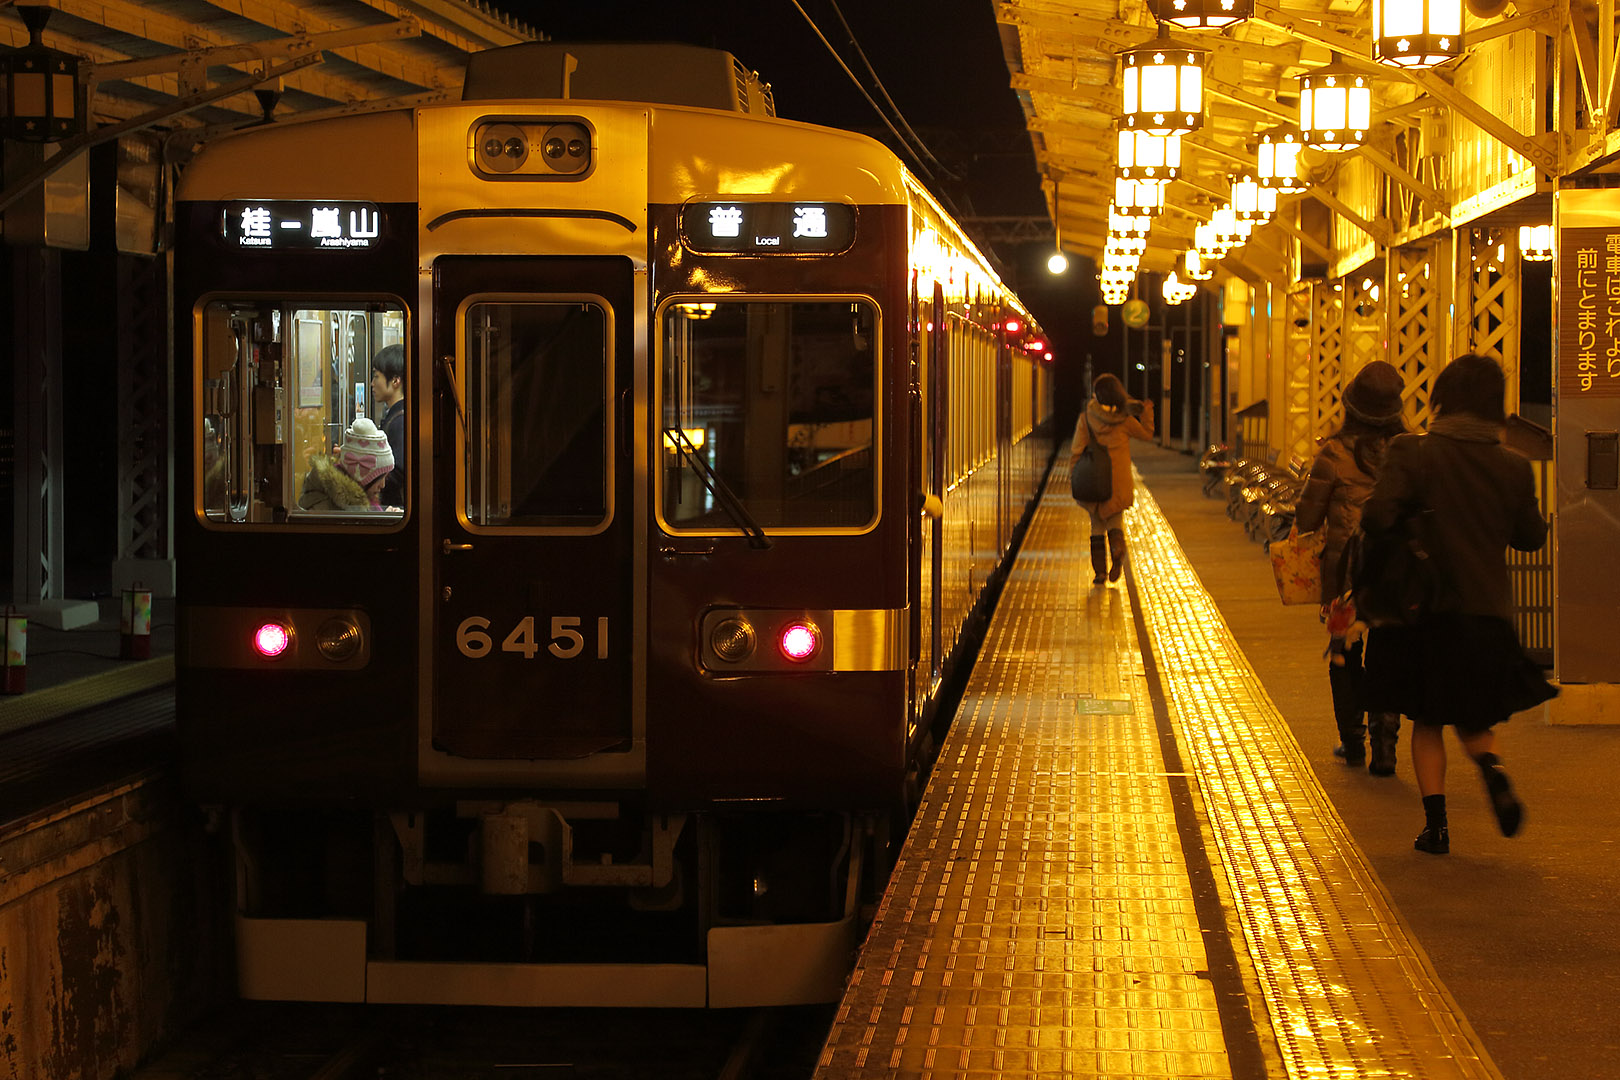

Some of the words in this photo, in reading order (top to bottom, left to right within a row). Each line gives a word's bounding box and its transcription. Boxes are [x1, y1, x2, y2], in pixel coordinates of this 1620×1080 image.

[708, 206, 828, 238] 普通
[239, 236, 272, 246] Katsura
[320, 237, 369, 247] Arashiyama
[755, 236, 780, 246] Local
[1576, 247, 1599, 392] 前にとまります
[1605, 233, 1620, 378] 電車はこれより
[455, 615, 609, 660] 6451
